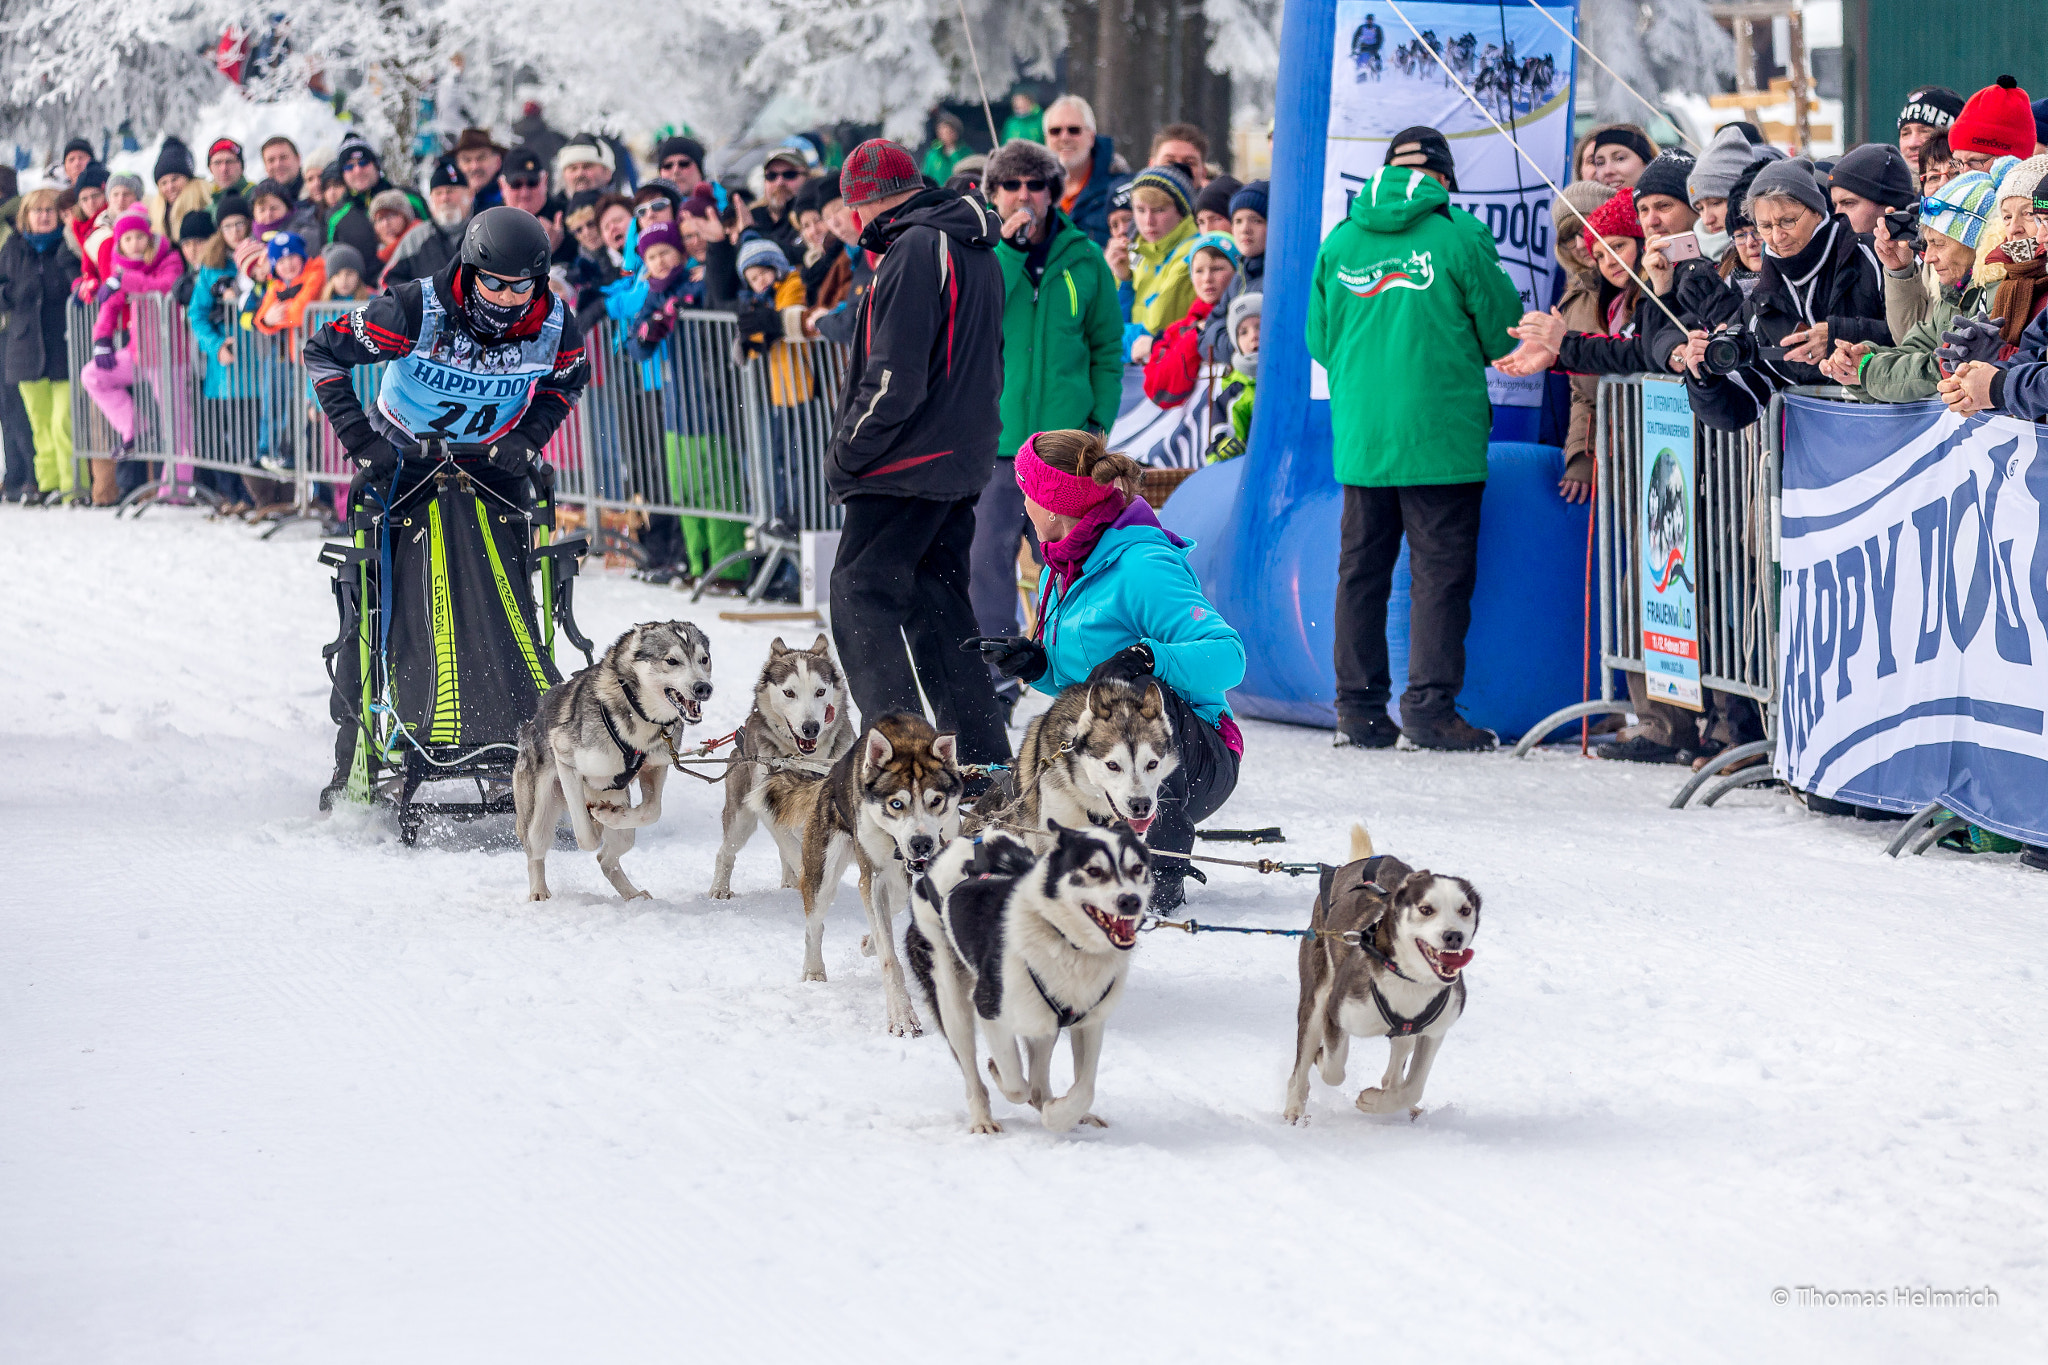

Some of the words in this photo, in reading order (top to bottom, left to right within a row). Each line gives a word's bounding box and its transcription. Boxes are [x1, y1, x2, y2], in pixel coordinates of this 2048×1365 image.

[1486, 199, 1549, 258] DOG
[412, 361, 490, 396] HAPPY
[428, 400, 500, 440] 24
[1912, 436, 2032, 667] DOG
[434, 574, 445, 634] CARBON
[496, 573, 528, 634] CARBON
